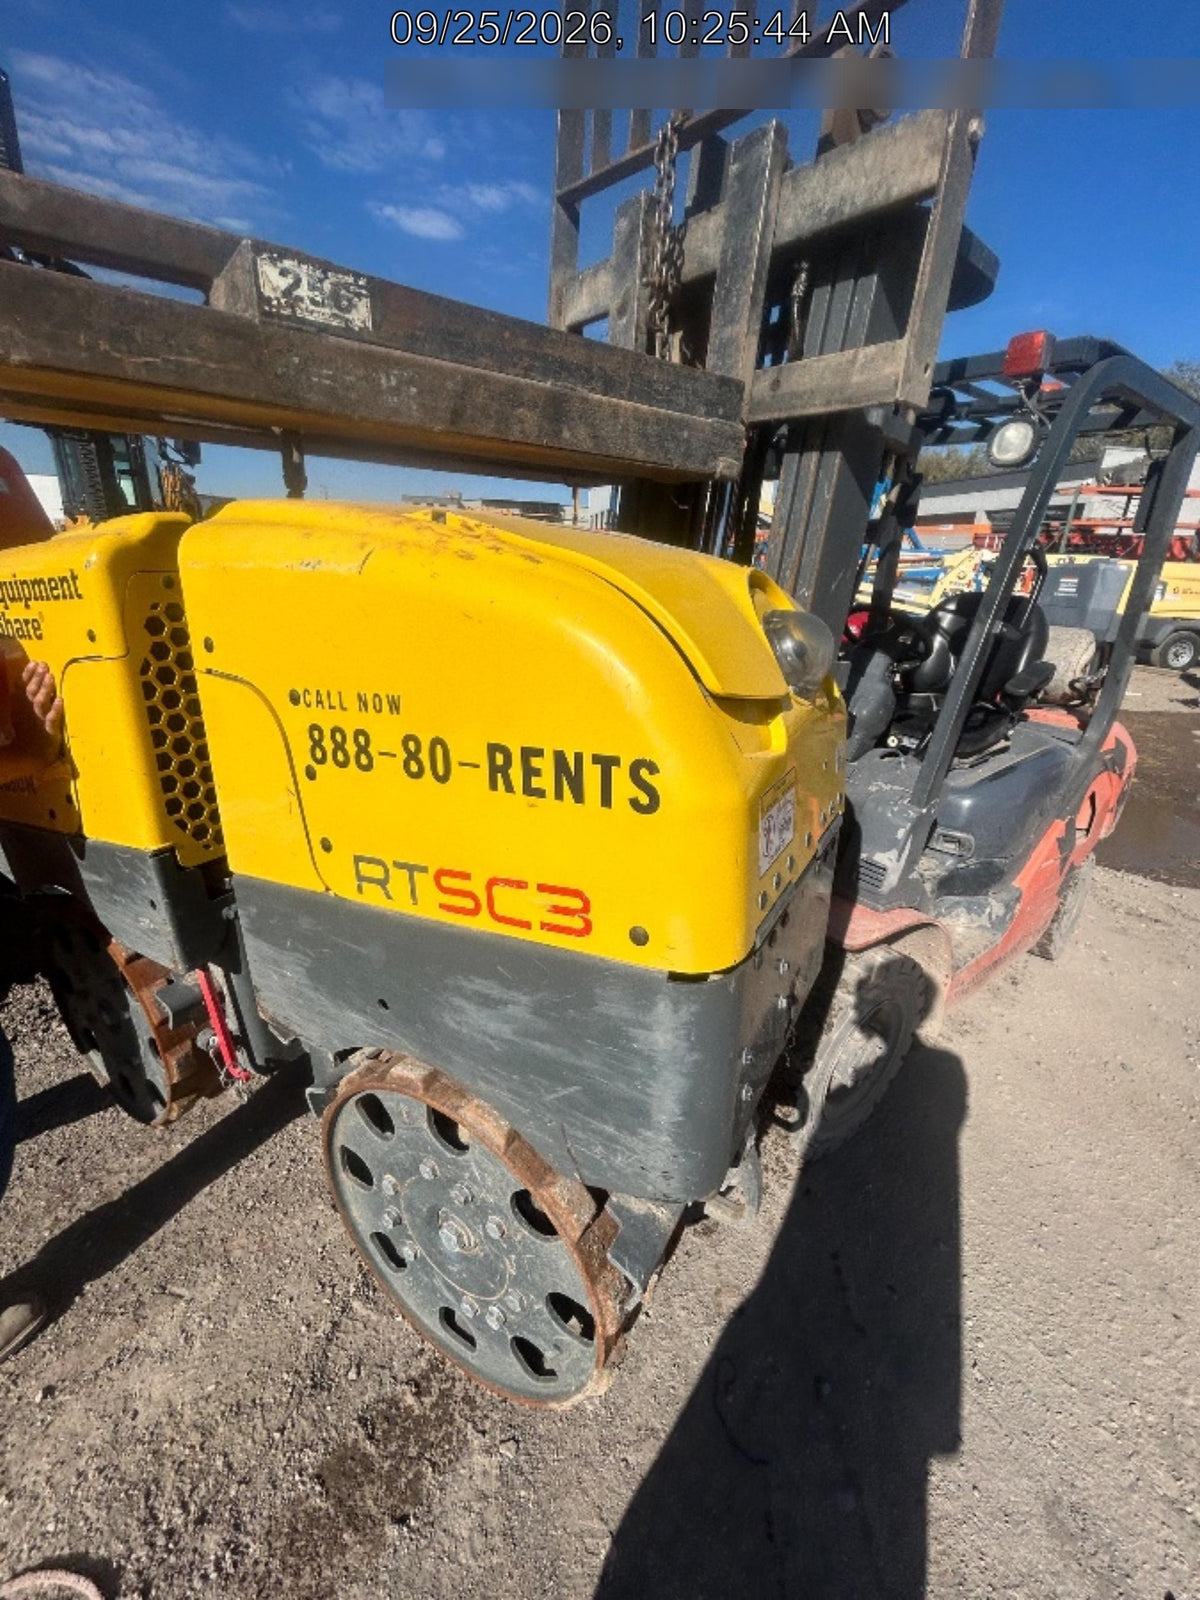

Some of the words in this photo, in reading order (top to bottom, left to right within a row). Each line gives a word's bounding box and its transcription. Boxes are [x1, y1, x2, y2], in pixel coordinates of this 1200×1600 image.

[303, 688, 348, 712] CALL
[356, 692, 401, 716] NOW
[308, 722, 661, 815] 888-80-RENTS
